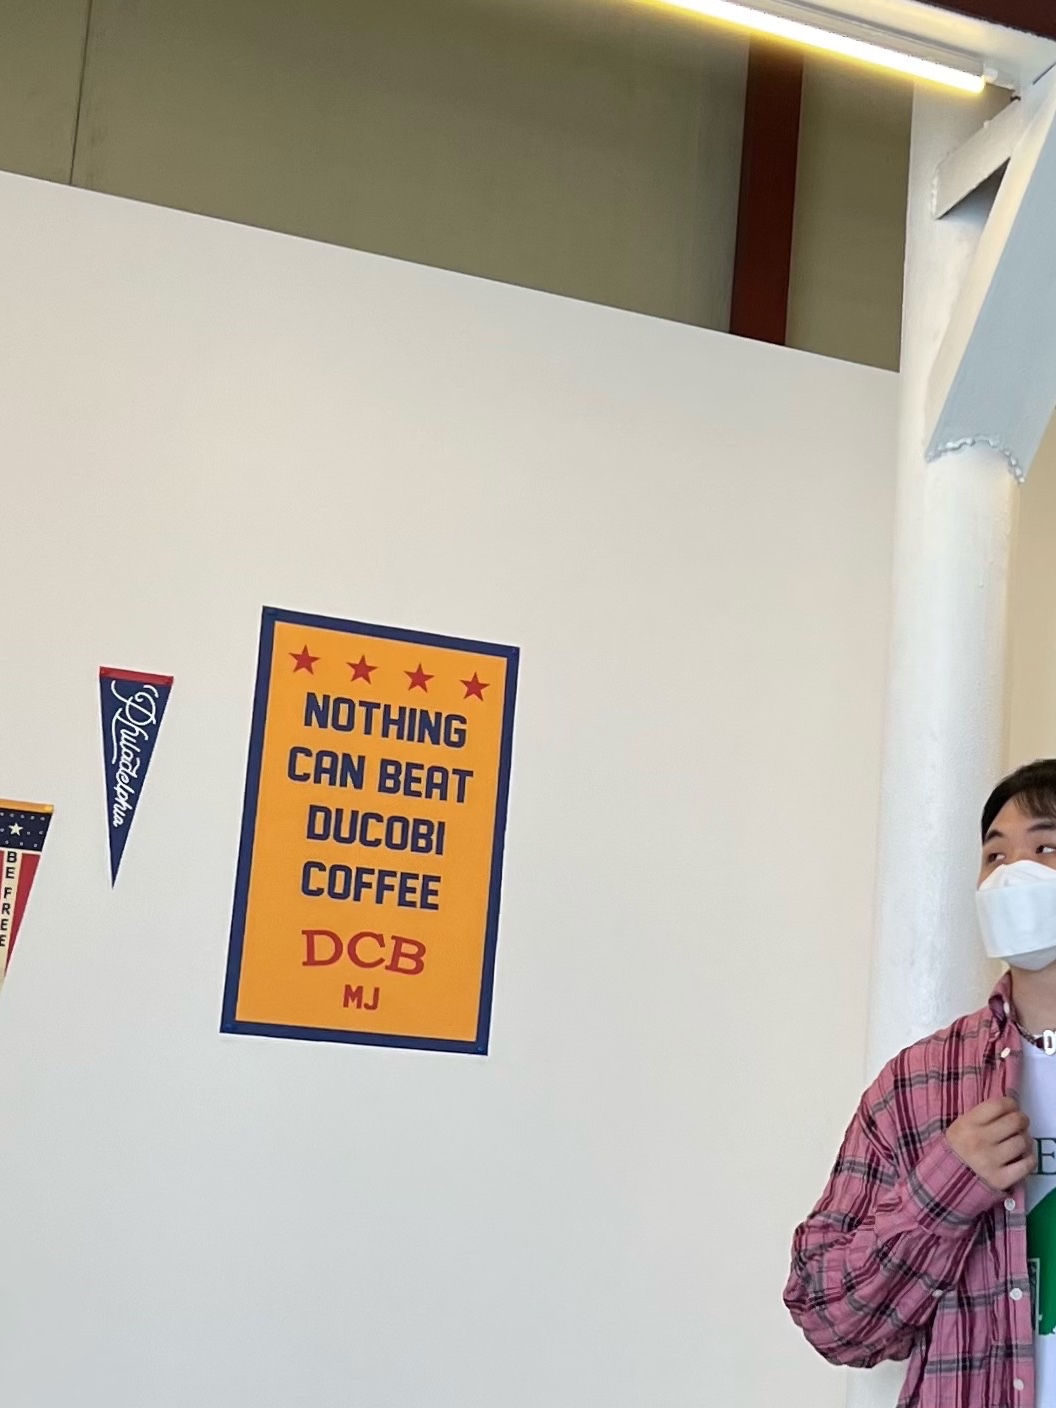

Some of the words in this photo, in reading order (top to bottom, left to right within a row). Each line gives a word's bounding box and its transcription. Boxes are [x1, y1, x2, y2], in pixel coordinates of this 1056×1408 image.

[304, 692, 468, 748] NOTHING
[111, 680, 159, 827] Philadelphia
[287, 746, 366, 790] CAN
[378, 759, 474, 803] BEAT
[306, 804, 446, 855] DUCOBI
[5, 851, 17, 879] BE
[301, 861, 442, 910] COFFEE
[0, 887, 12, 947] FREE
[302, 929, 427, 975] DCB
[343, 985, 381, 1011] MJ
